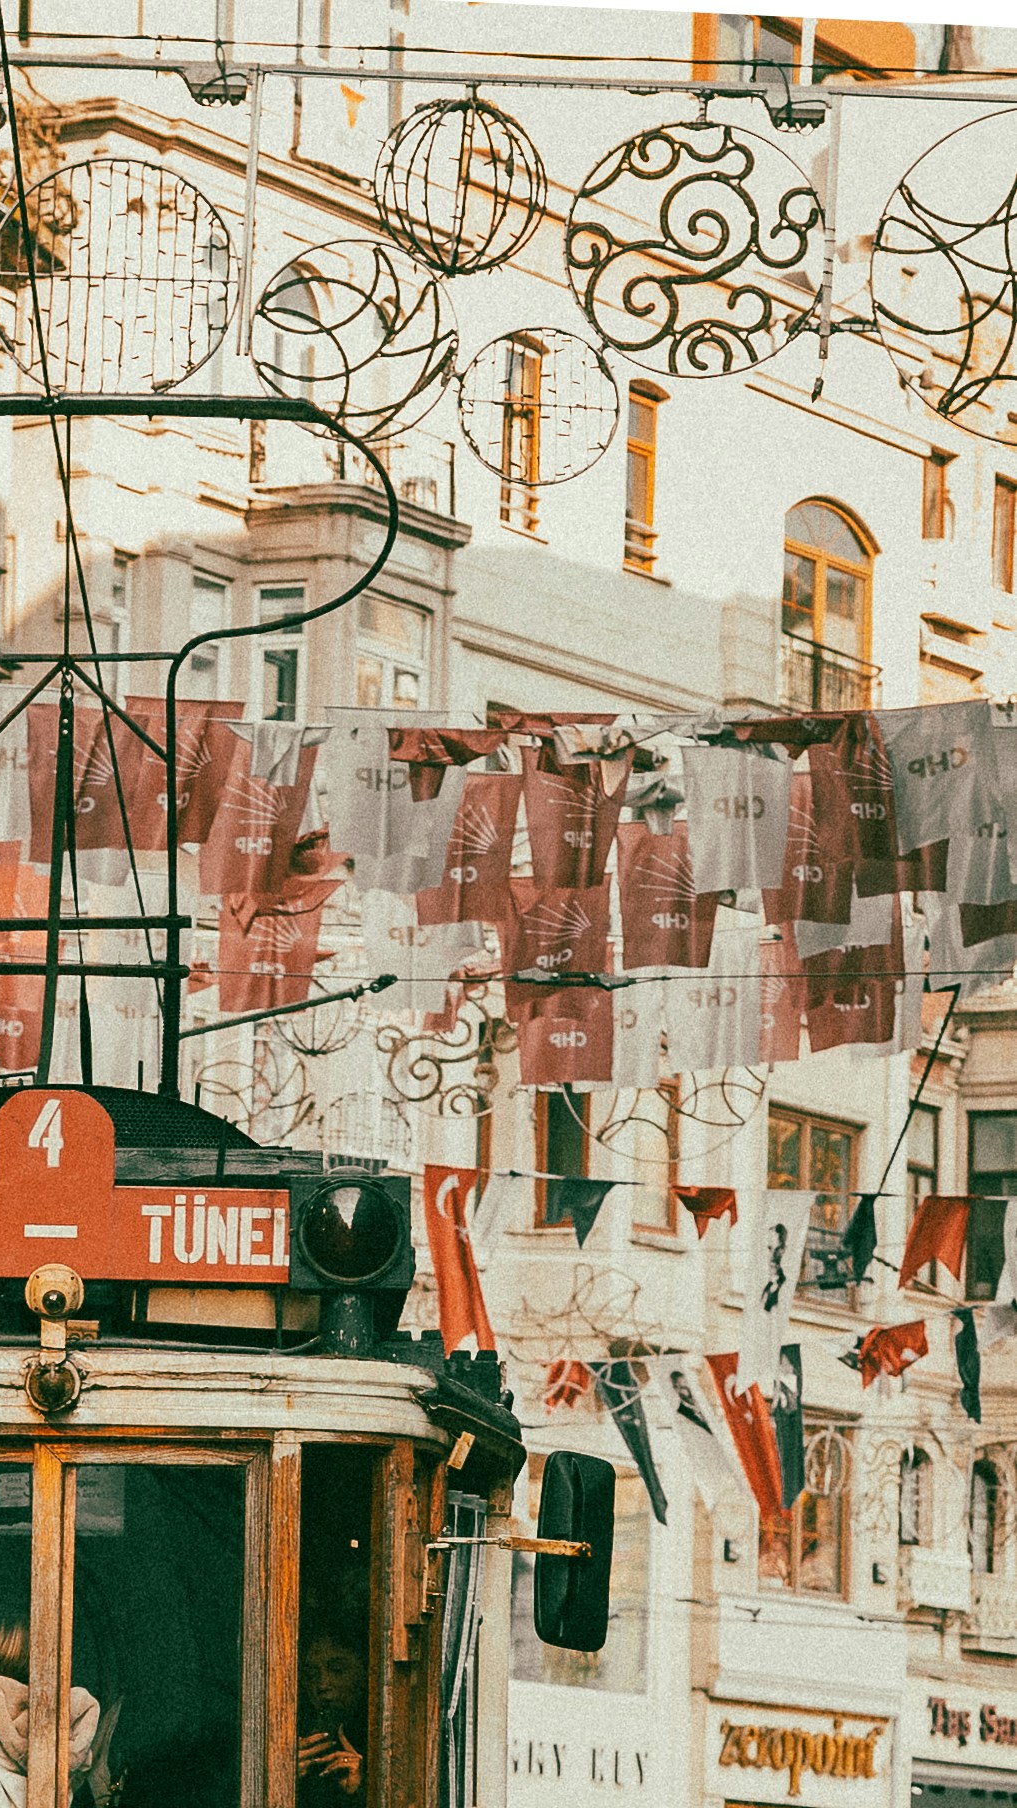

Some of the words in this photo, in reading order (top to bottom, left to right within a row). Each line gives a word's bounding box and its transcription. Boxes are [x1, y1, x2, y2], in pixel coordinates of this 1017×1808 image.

[28, 1098, 64, 1168] 4
[141, 1194, 290, 1267] TÜNEL
[719, 1719, 884, 1797] zeropoint
